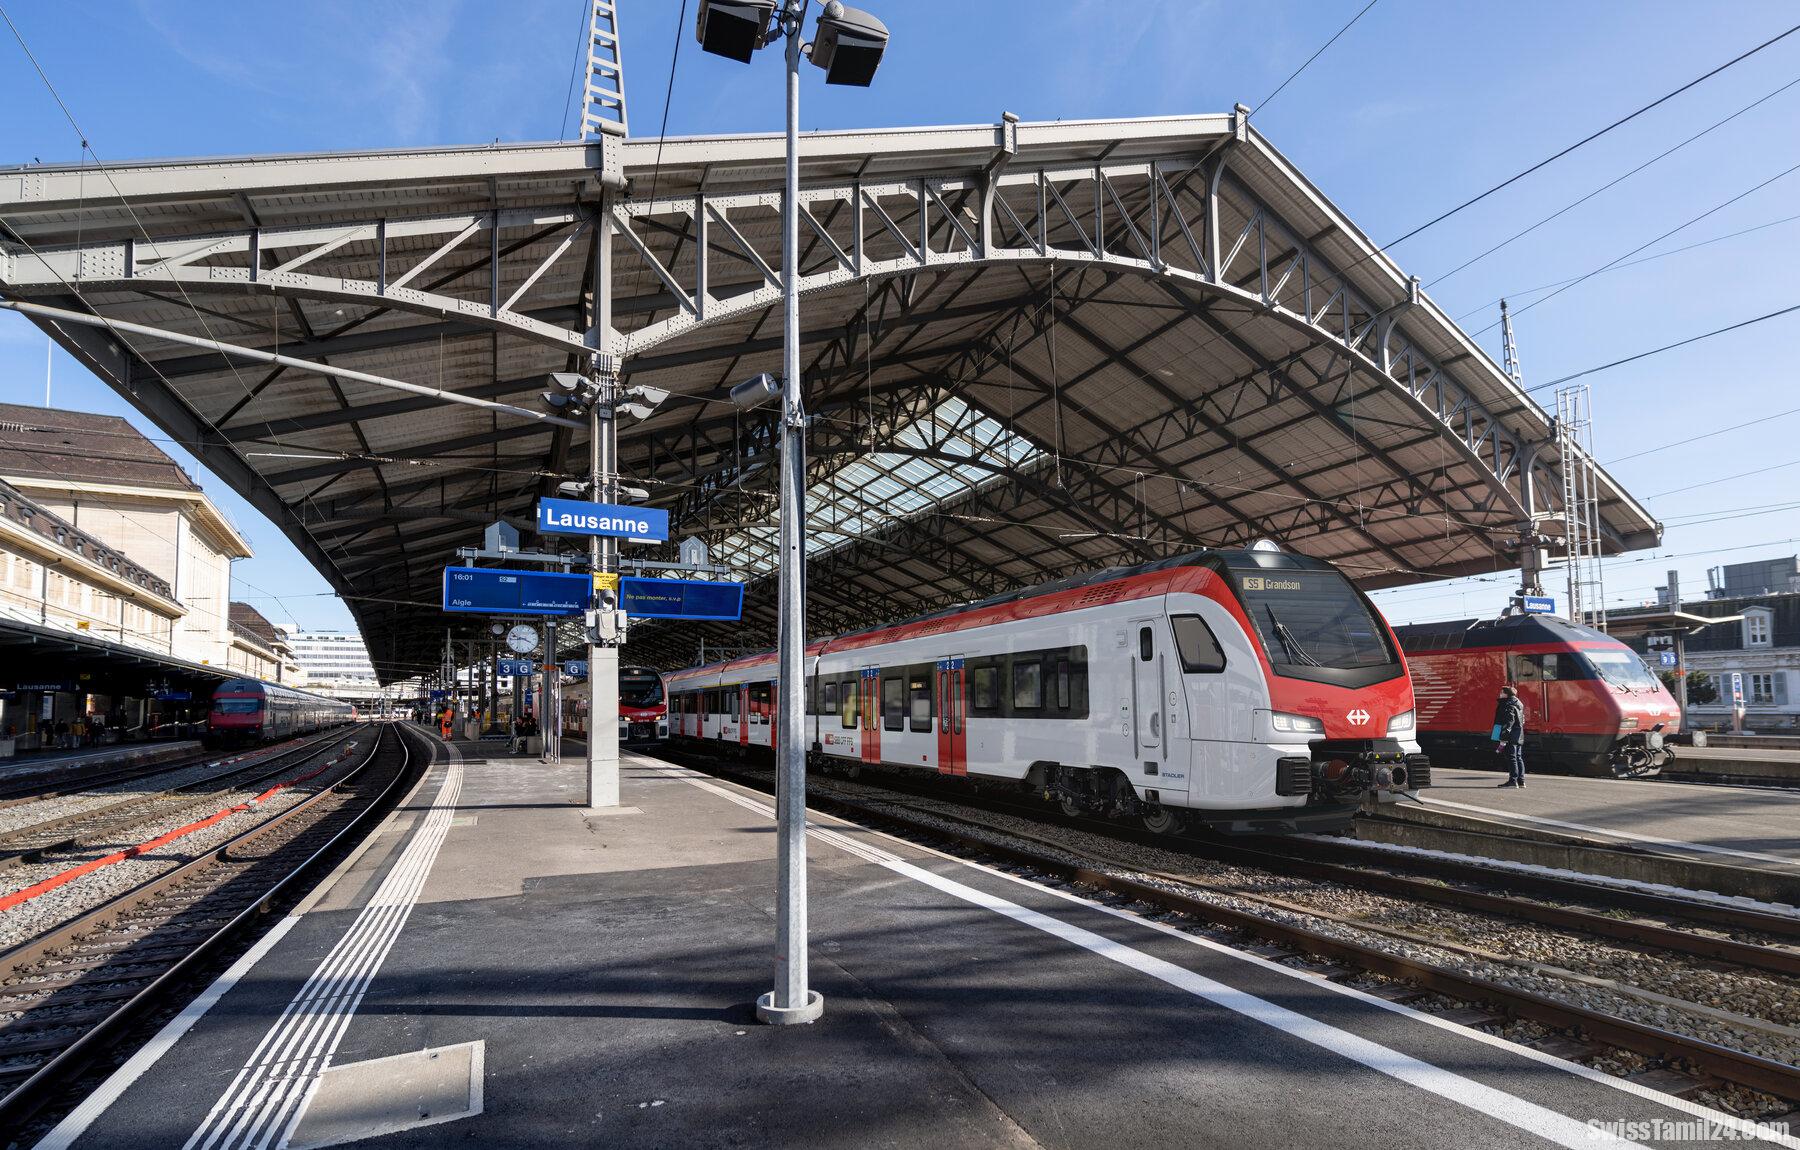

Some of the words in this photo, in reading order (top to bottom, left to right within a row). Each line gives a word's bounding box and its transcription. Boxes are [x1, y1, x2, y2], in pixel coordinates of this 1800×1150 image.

[546, 508, 649, 534] Lausanne
[453, 573, 473, 581] 16:01
[1248, 578, 1259, 589] S5
[1265, 578, 1301, 590] Grandson
[451, 599, 472, 607] Aigle
[1525, 600, 1552, 611] Lausanne
[503, 664, 510, 674] 3
[519, 664, 528, 674] G
[570, 665, 579, 674] G
